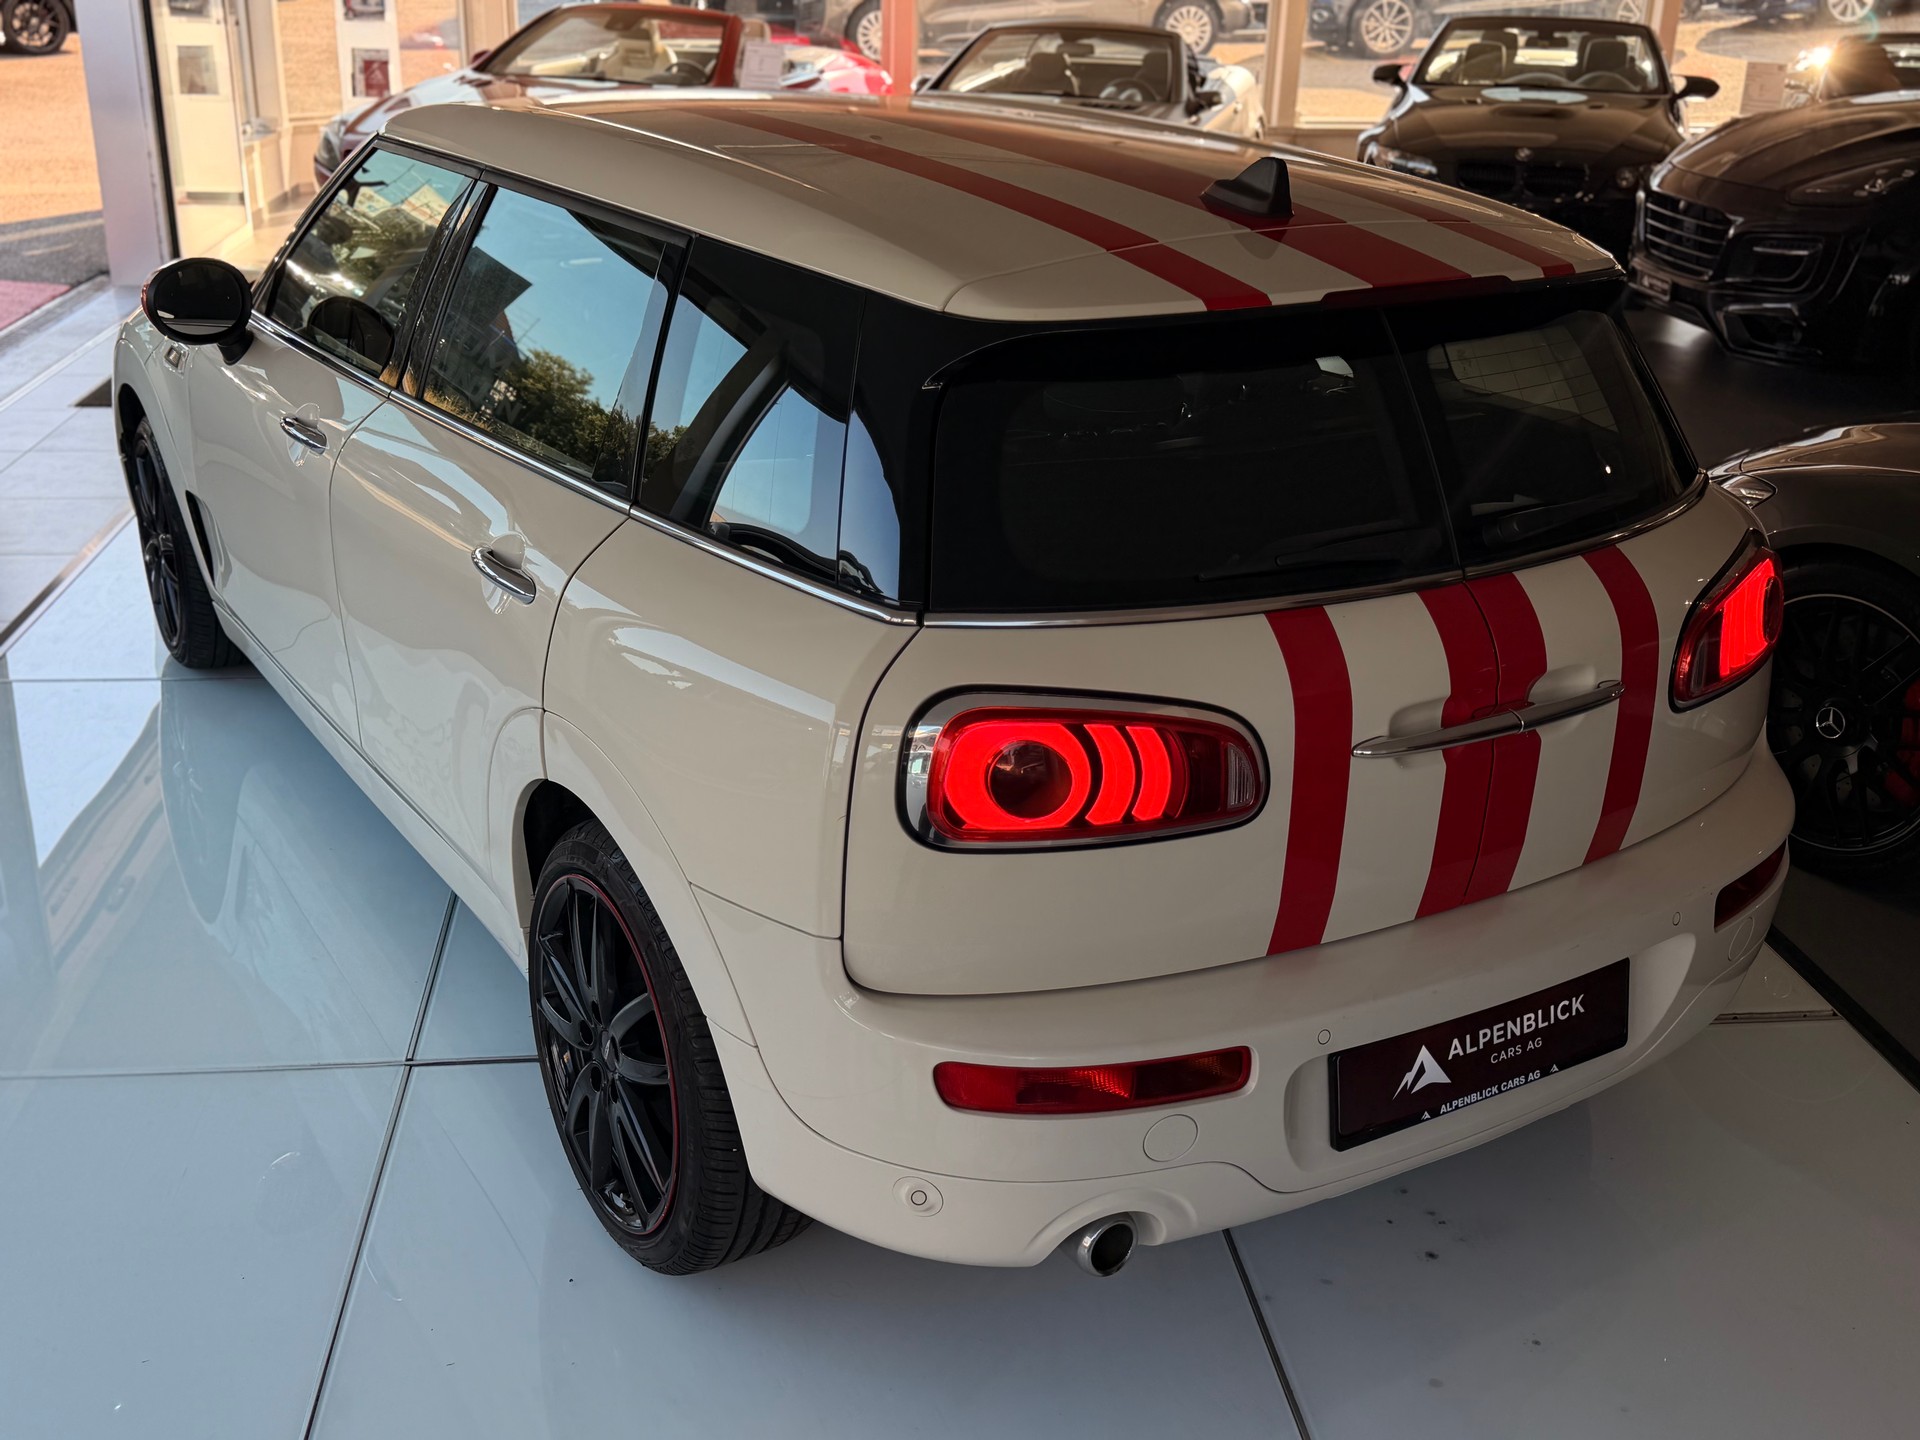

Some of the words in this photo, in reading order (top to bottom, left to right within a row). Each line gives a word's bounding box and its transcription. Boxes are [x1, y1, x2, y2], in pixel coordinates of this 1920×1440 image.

[1448, 993, 1585, 1061] ALPENBLICK
[1490, 1044, 1522, 1064] CARS
[1526, 1037, 1543, 1052] AG
[1440, 1085, 1499, 1114] ALPENBLICK
[1500, 1075, 1525, 1091] CARS
[1527, 1069, 1541, 1082] AG
